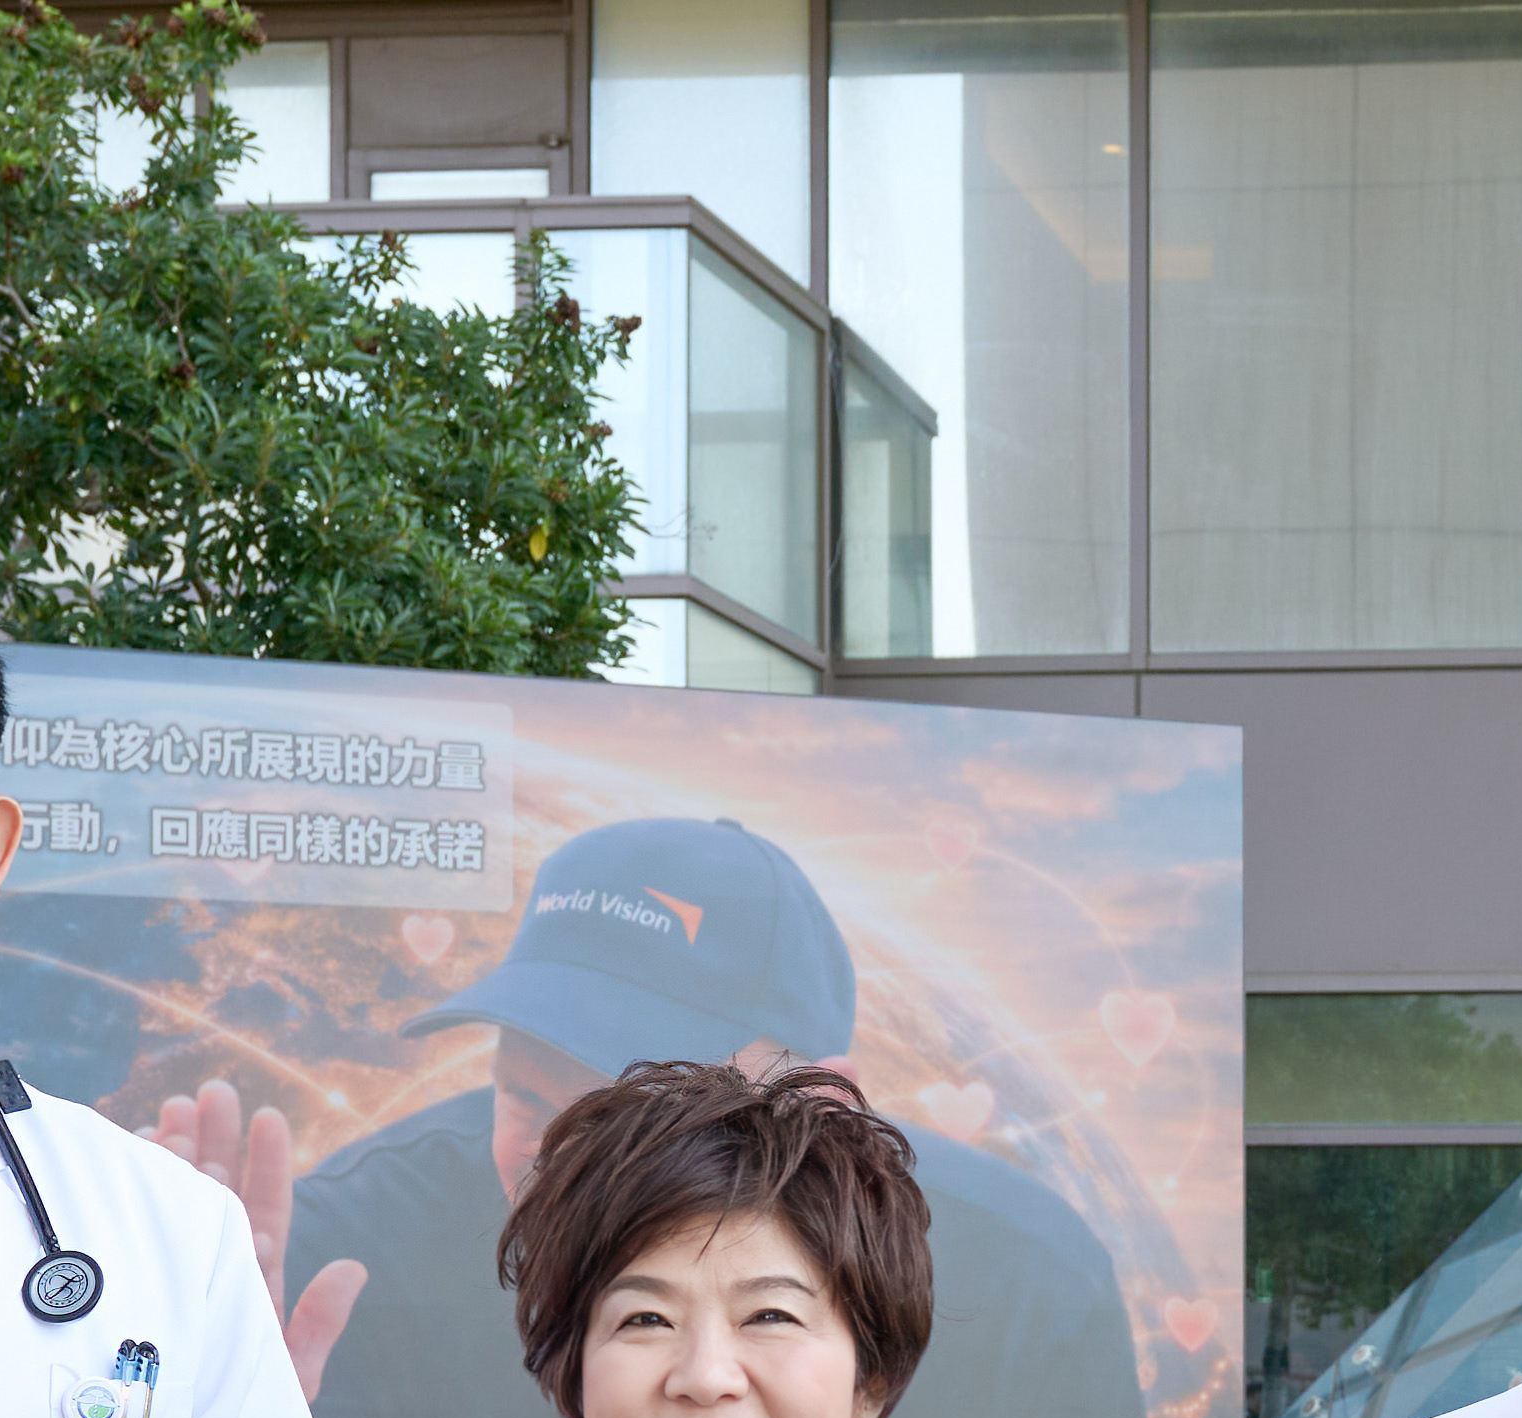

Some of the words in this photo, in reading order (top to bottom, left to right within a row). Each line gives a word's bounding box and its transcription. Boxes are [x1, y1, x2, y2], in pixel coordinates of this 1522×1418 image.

[1, 716, 484, 790] 仰為核心所展現的力量
[535, 889, 596, 915] World
[601, 891, 672, 934] Vision
